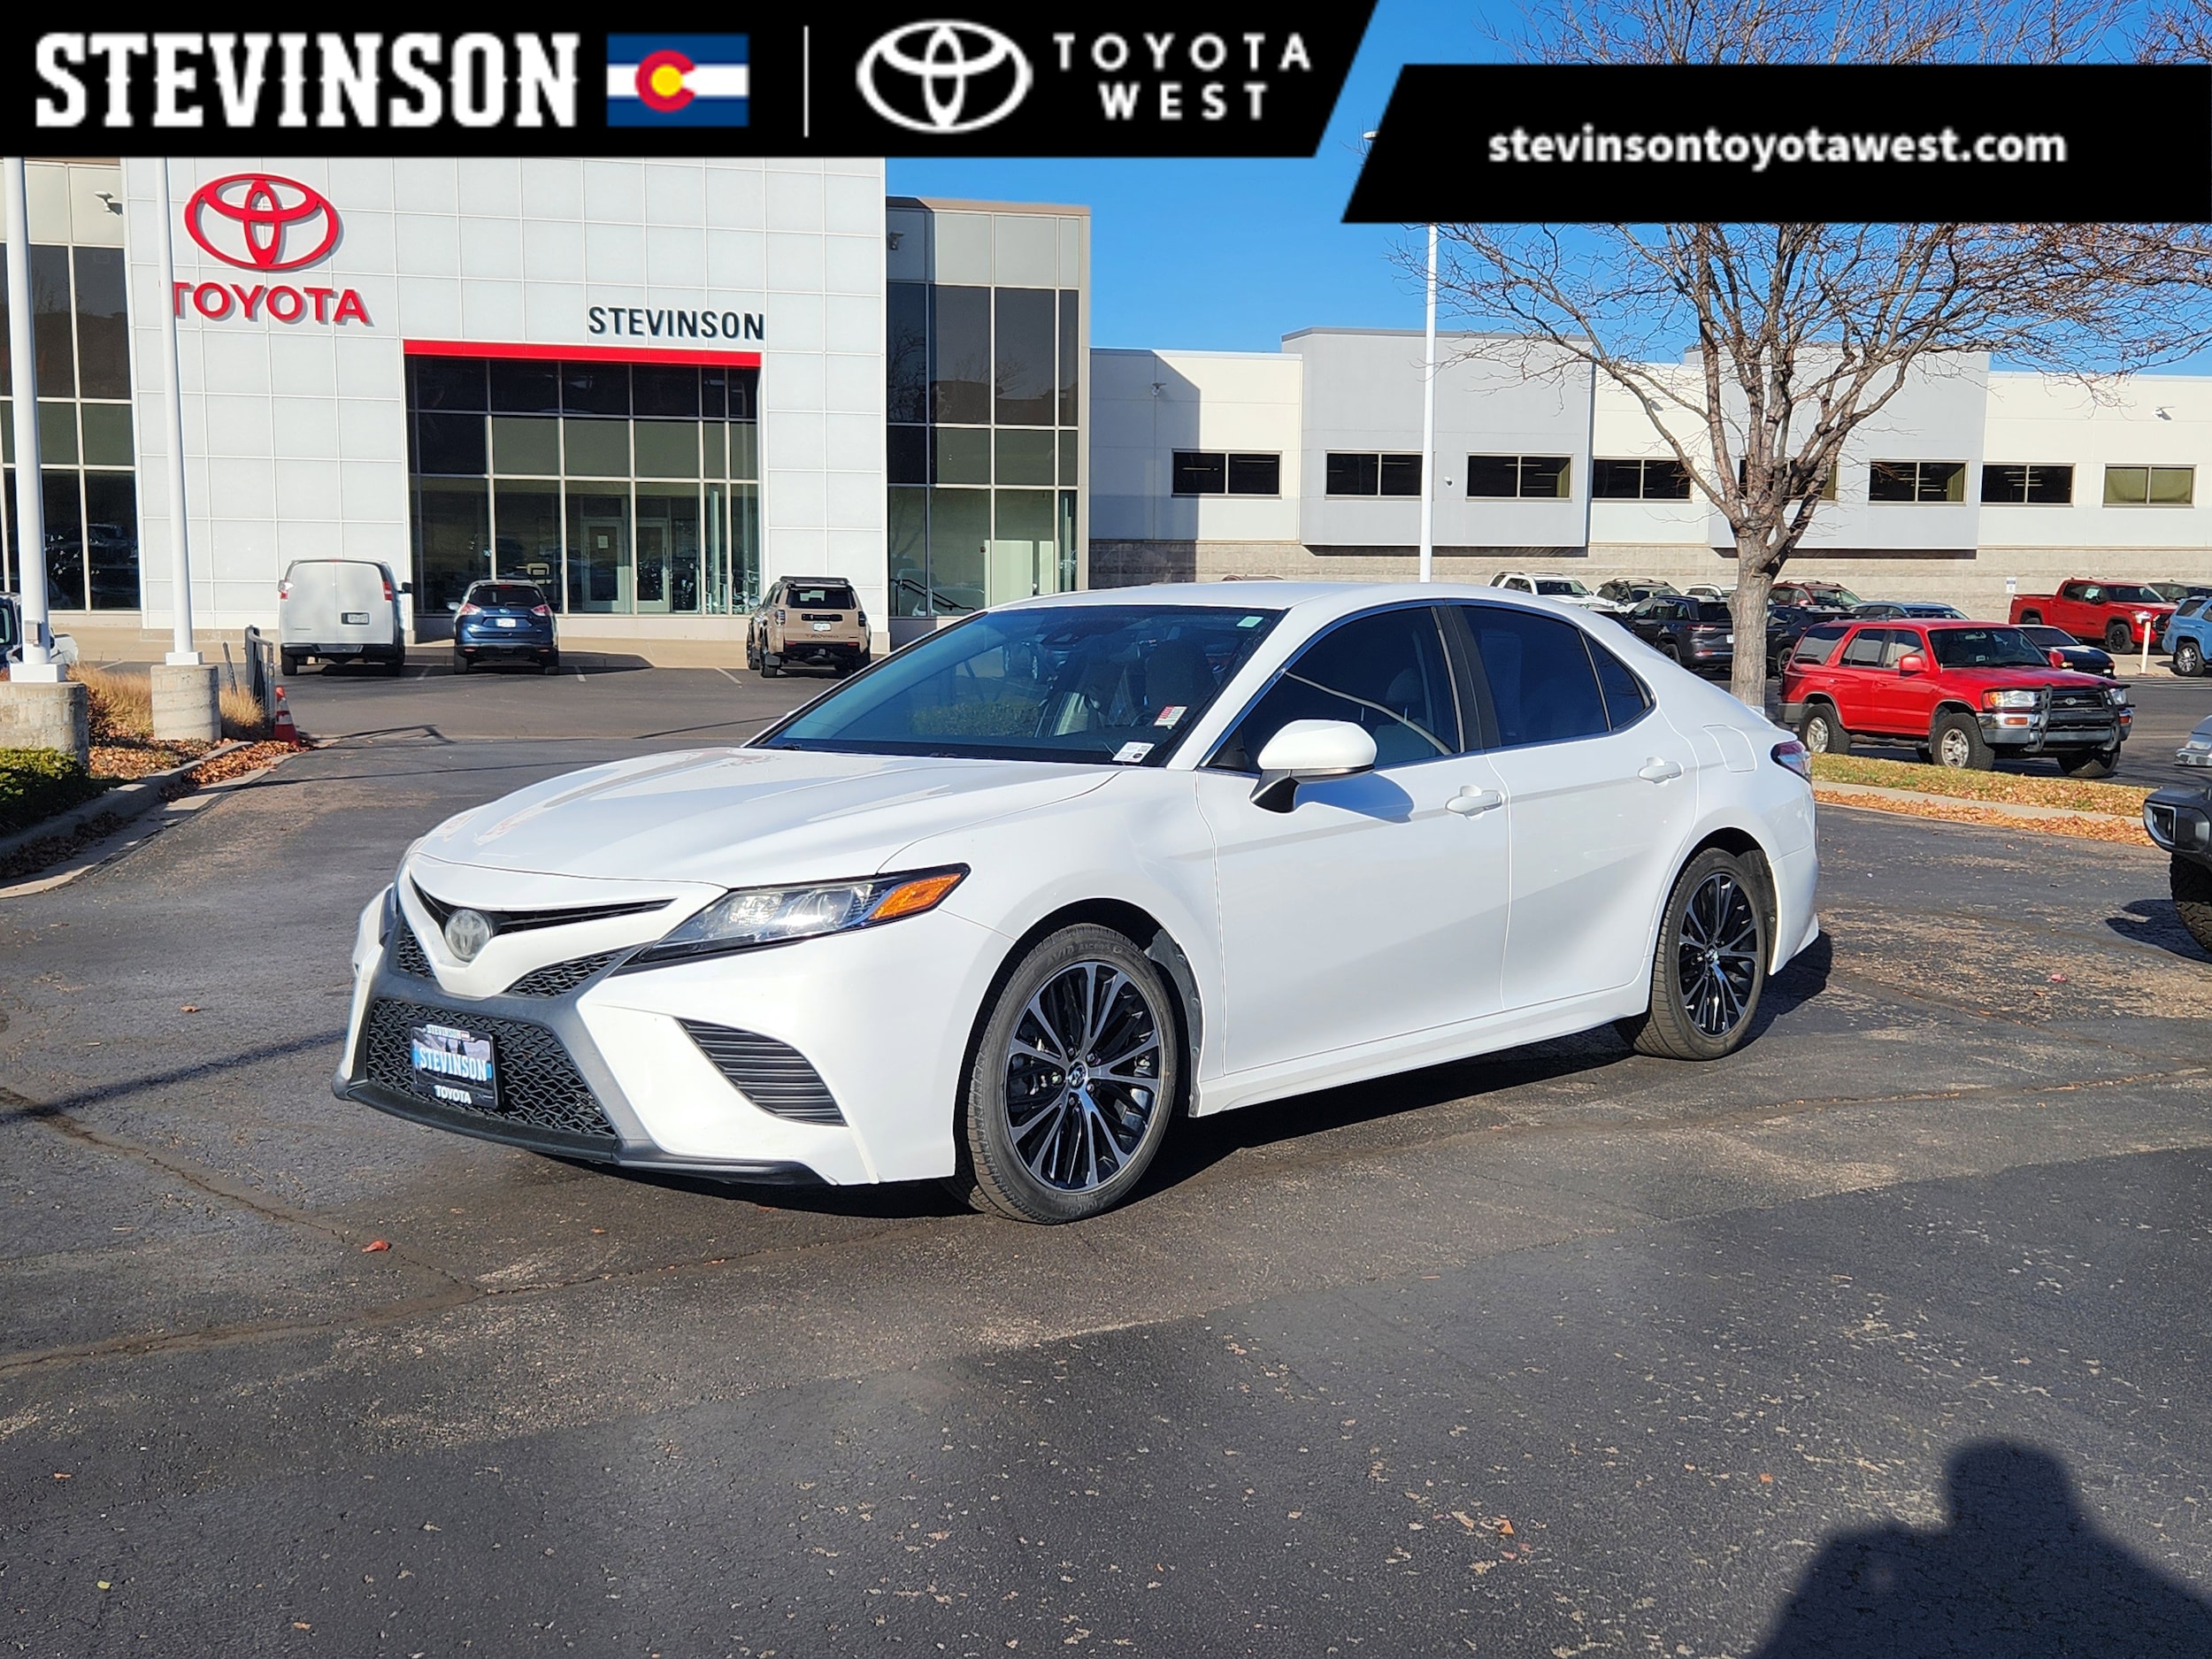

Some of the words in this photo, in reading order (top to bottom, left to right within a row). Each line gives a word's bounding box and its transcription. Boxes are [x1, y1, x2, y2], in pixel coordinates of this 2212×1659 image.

[173, 281, 370, 323] TOYOTA
[588, 306, 764, 341] STEVINSON
[419, 1047, 488, 1081] STEVINSON
[434, 1084, 472, 1104] TOYOTA
